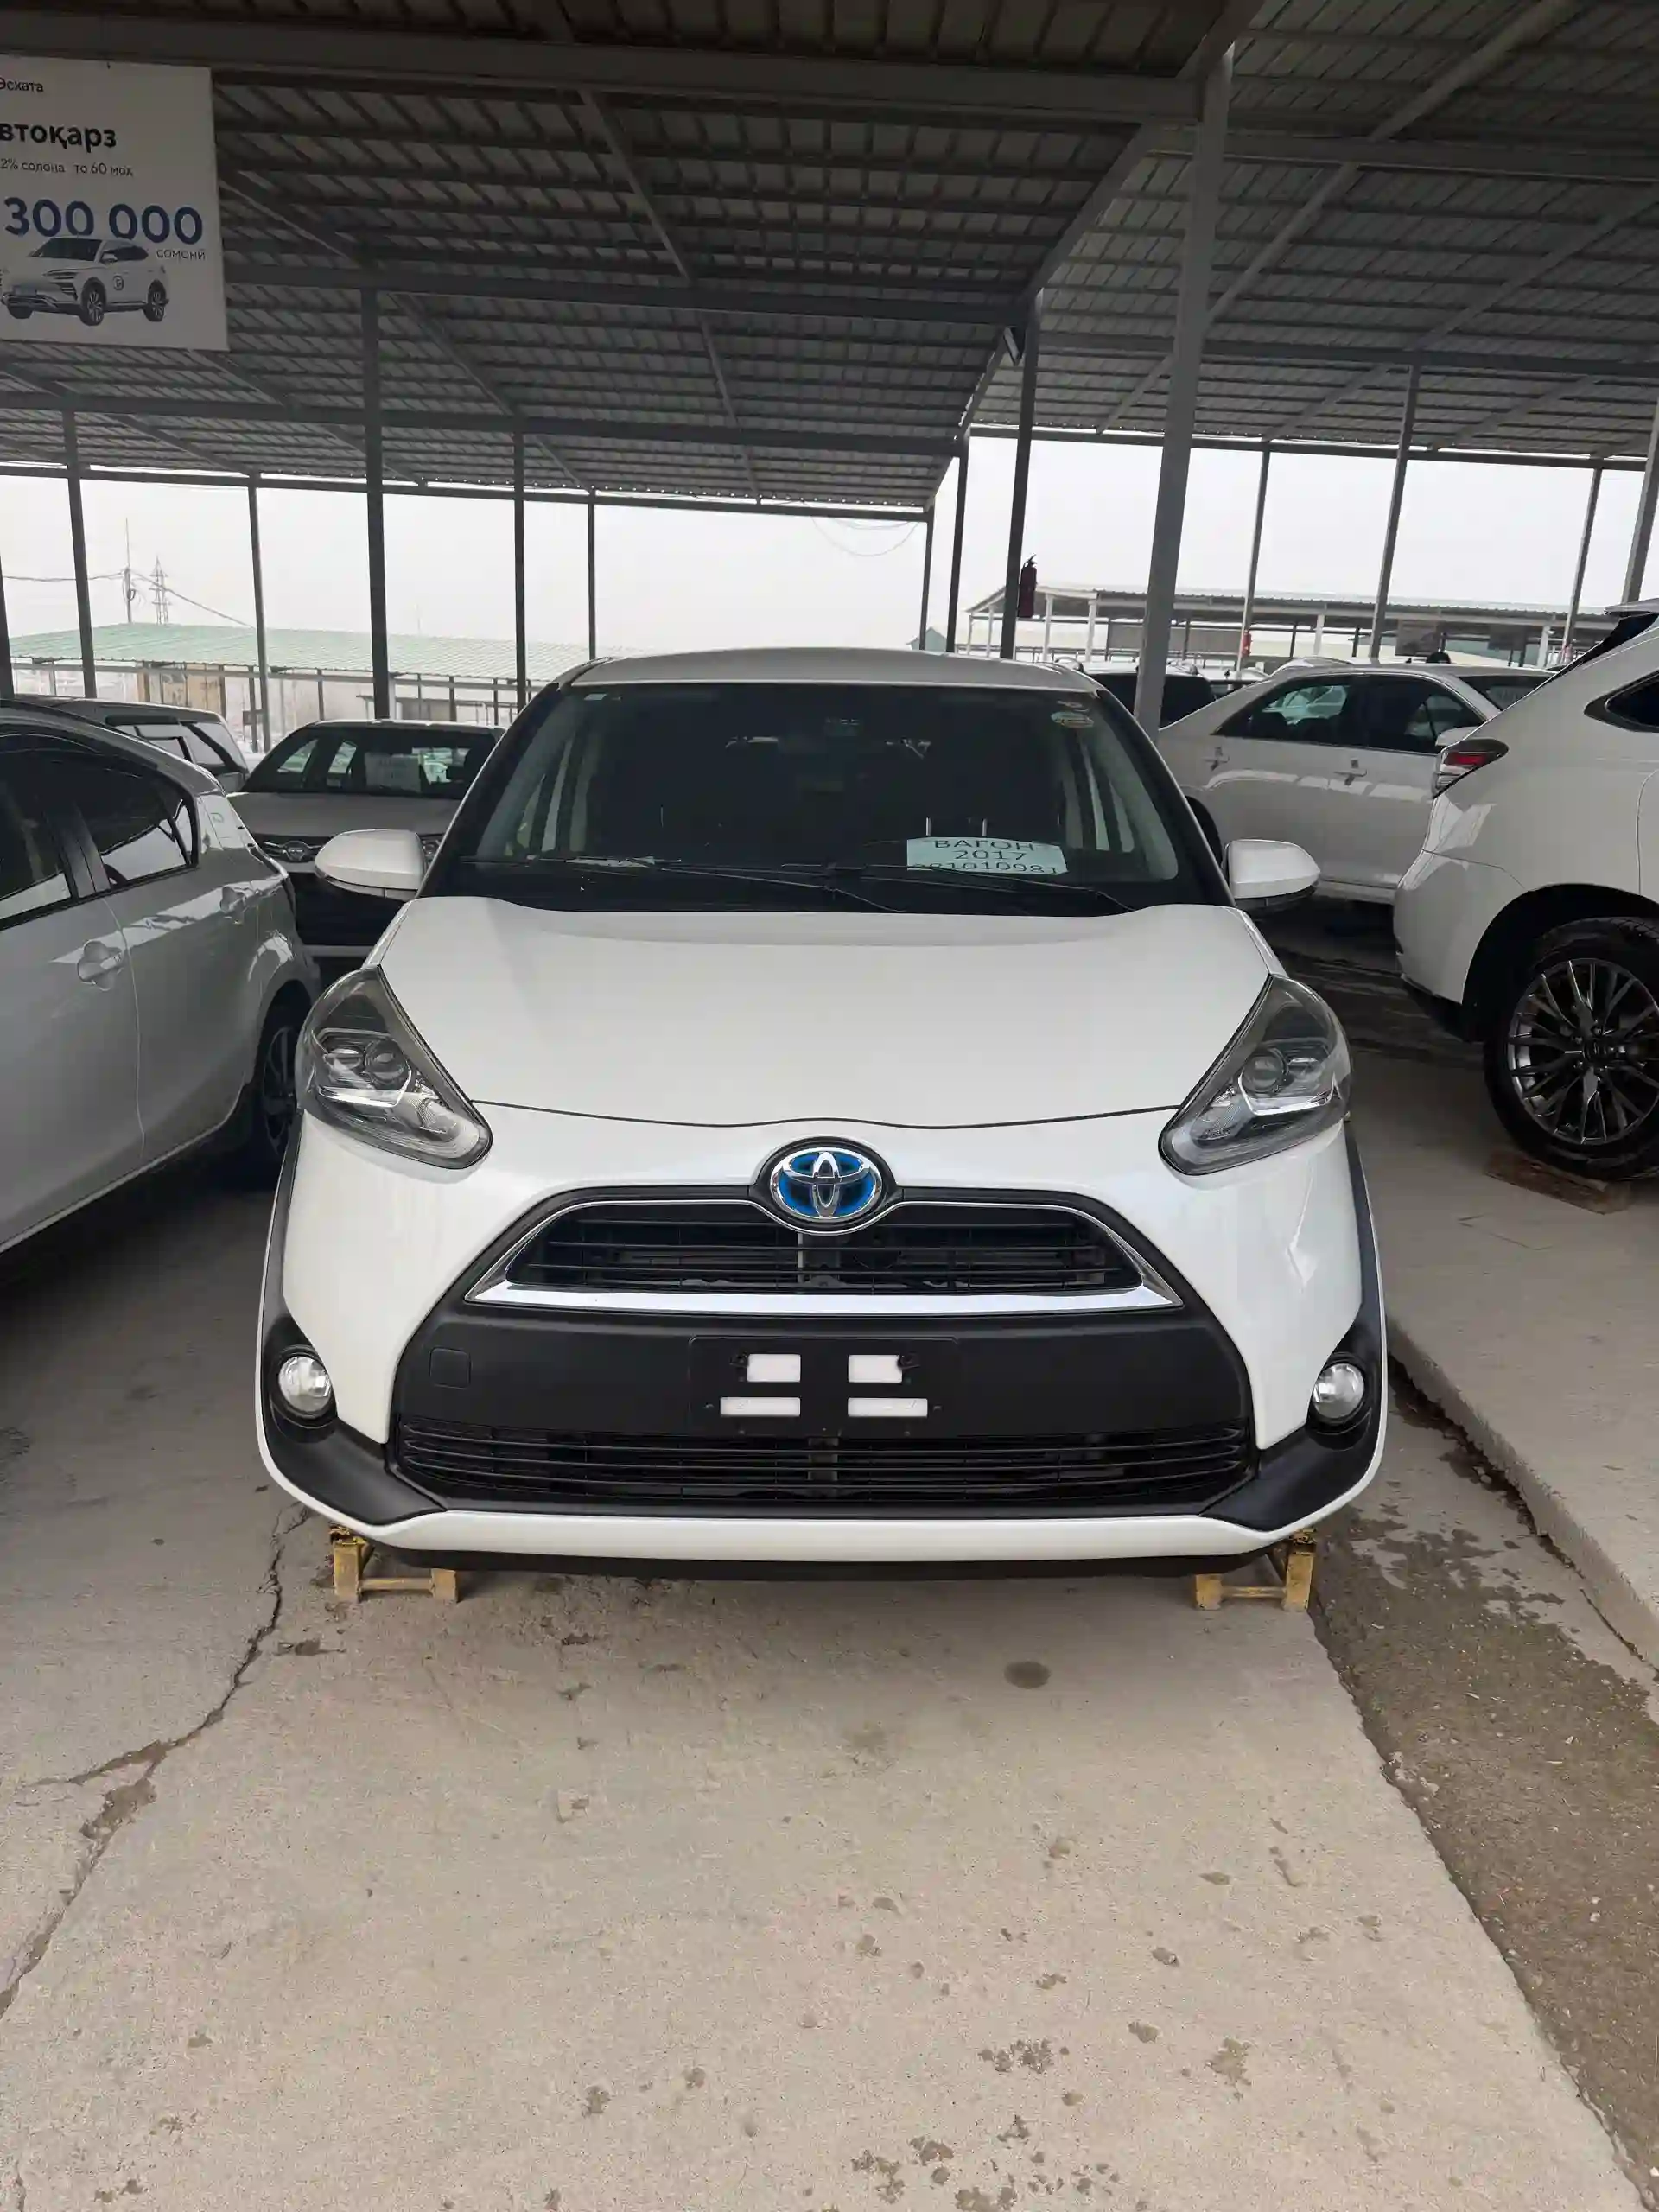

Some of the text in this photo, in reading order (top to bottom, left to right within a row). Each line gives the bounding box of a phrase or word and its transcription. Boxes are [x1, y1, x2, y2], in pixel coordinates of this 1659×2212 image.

[22, 162, 66, 173] солона
[73, 164, 88, 174] то
[91, 162, 107, 175] 60
[4, 197, 203, 245] 300 000
[934, 840, 1034, 852] ВАГОН
[952, 850, 1027, 861] 2017
